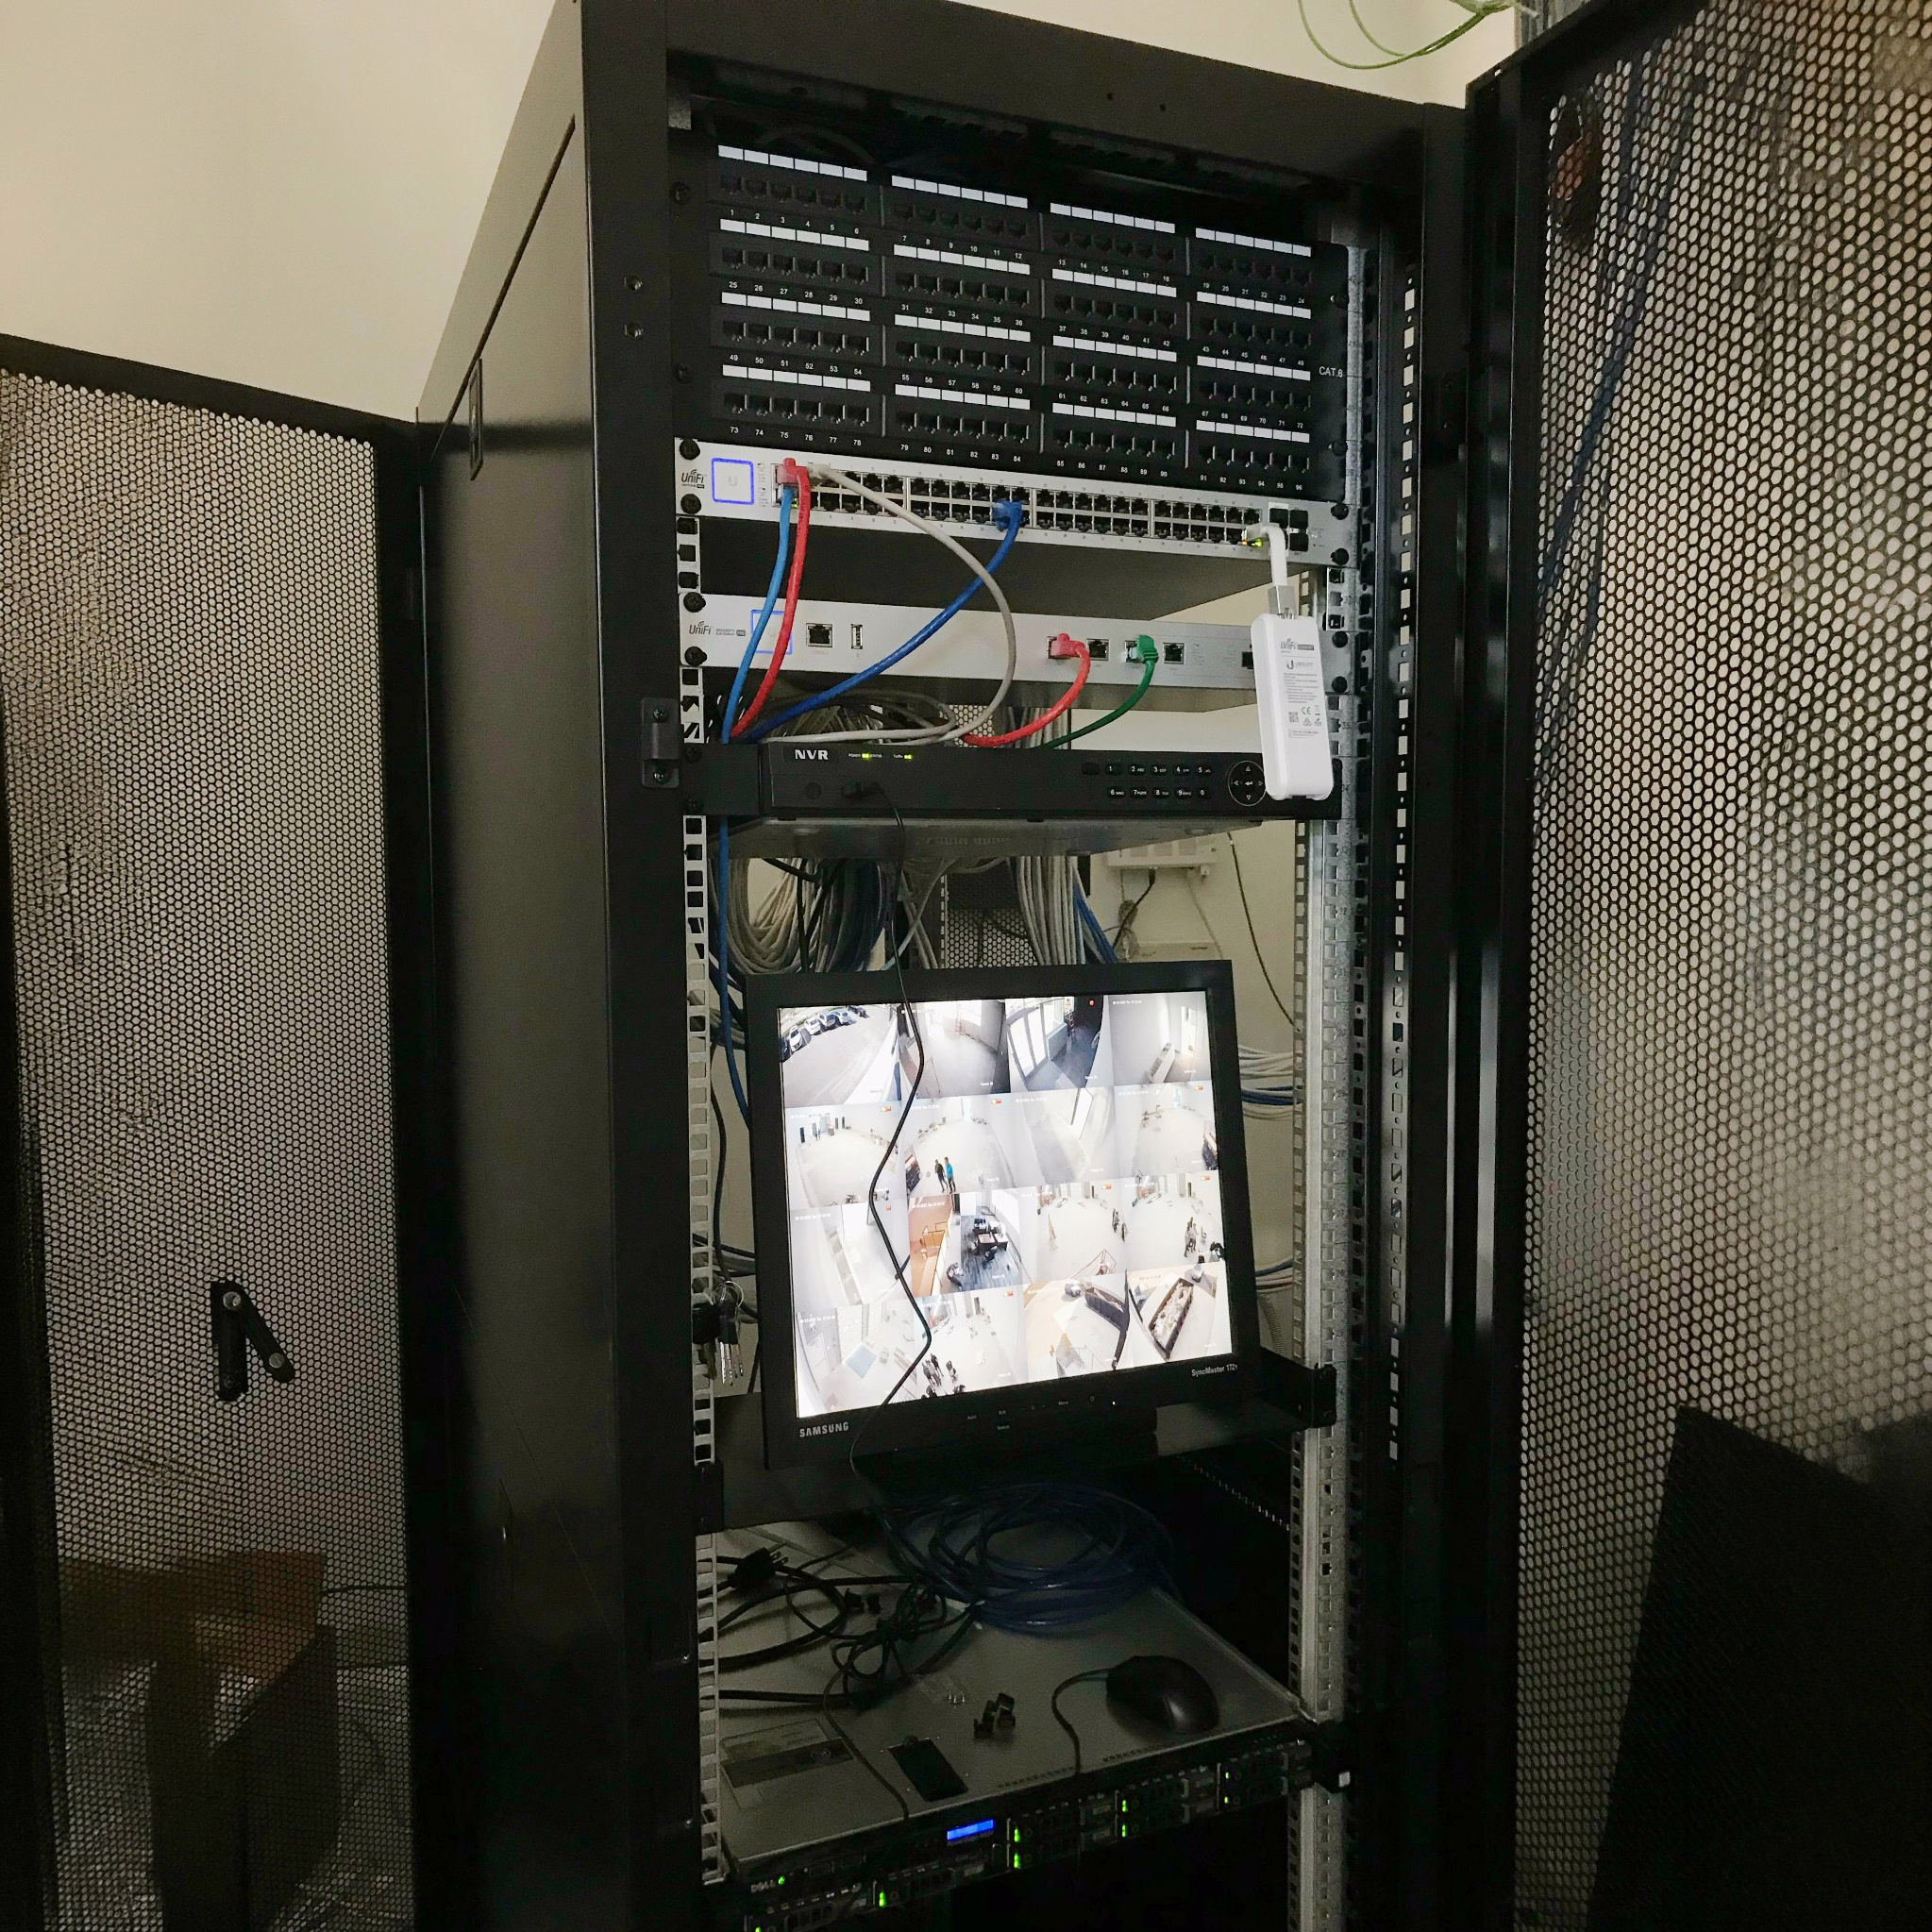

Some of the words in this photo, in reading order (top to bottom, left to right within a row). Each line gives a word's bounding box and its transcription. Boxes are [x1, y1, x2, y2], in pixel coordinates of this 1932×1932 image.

[729, 280, 738, 289] 25
[779, 287, 788, 295] 27
[829, 294, 838, 302] 29
[948, 310, 956, 318] 33
[993, 315, 1001, 324] 35
[1080, 328, 1088, 336] 38
[1100, 330, 1110, 339] 39
[1319, 365, 1343, 378] CAT.6
[1079, 395, 1087, 403] 62
[730, 426, 739, 434] 73
[923, 445, 932, 454] 80
[969, 450, 979, 459] 82
[681, 470, 704, 483] UniFi
[689, 622, 712, 635] UniFi
[795, 748, 829, 761] NVR
[1191, 1366, 1225, 1377] SyncMaster
[798, 1421, 849, 1437] SAMSUNG
